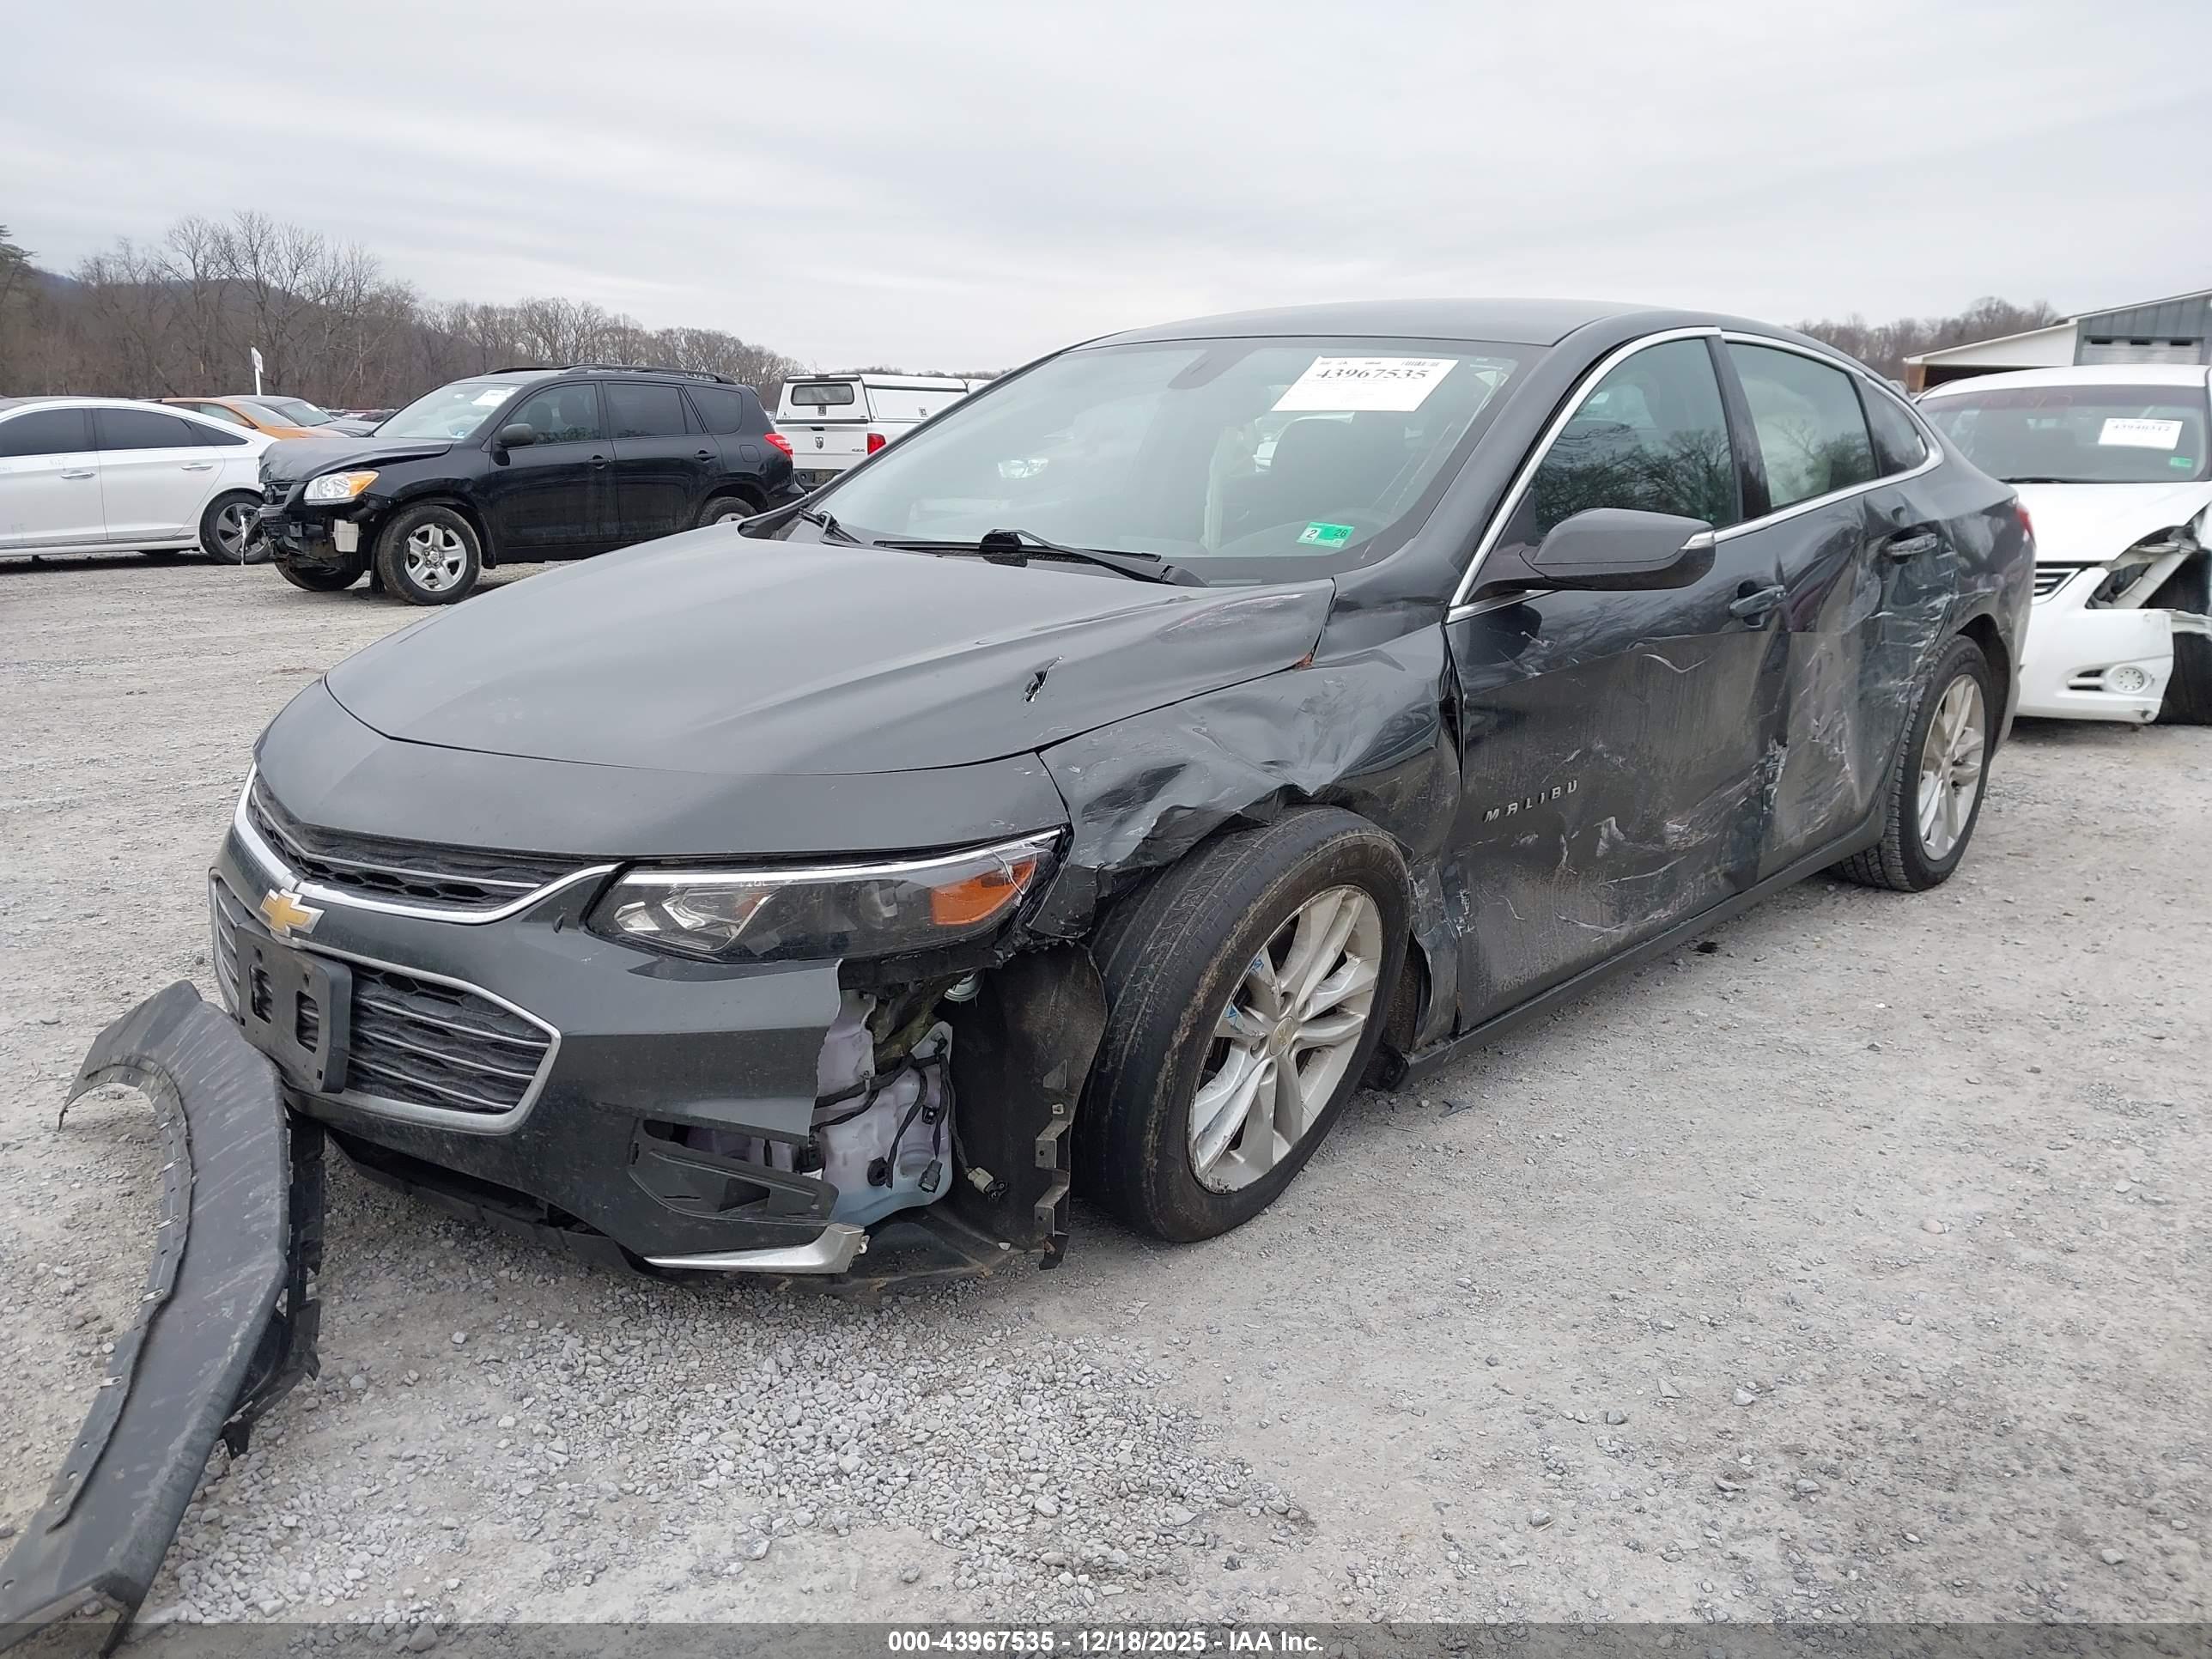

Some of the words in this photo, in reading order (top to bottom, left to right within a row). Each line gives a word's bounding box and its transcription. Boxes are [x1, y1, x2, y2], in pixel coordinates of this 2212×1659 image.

[1316, 368, 1430, 380] 43967535
[1306, 529, 1318, 538] 2
[1483, 779, 1578, 823] MALIBU
